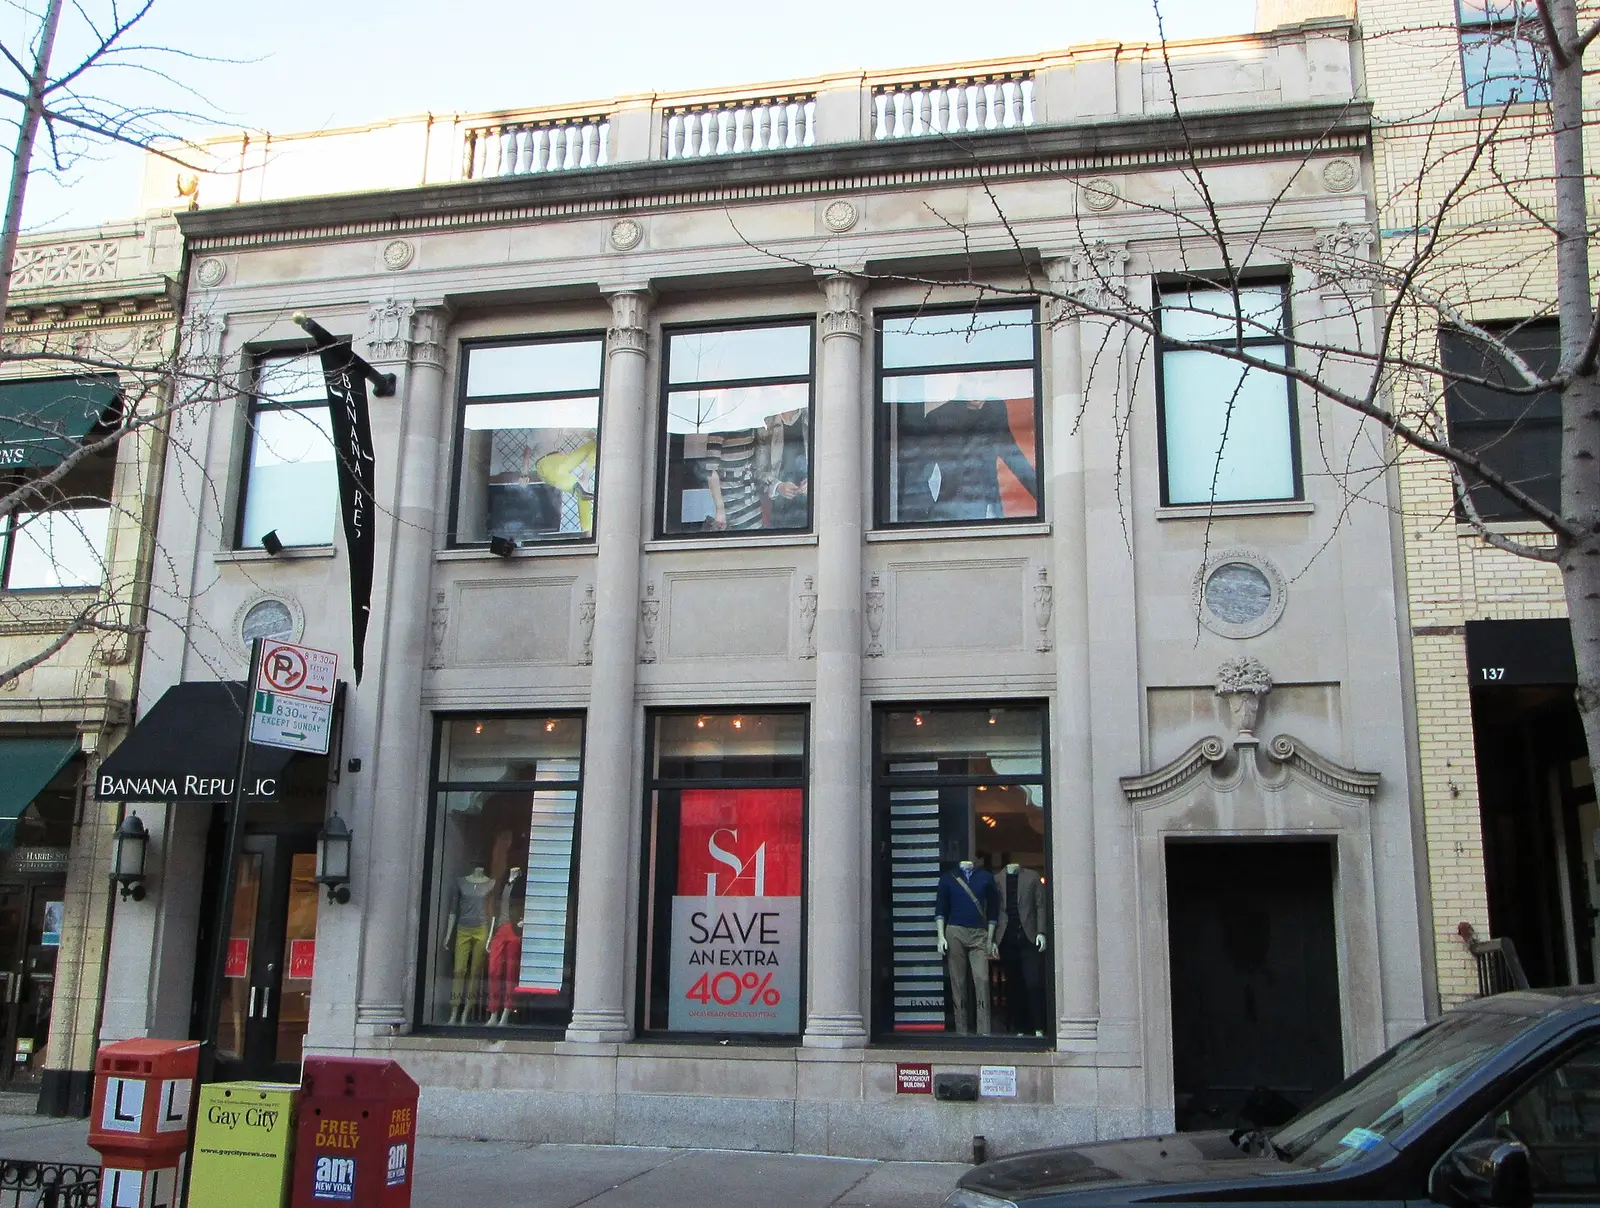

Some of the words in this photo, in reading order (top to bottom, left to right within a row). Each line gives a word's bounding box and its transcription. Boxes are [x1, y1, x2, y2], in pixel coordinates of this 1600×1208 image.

[342, 373, 362, 477] BANANA
[0, 448, 25, 465] NS
[1482, 668, 1505, 680] 137
[261, 715, 290, 728] EXCEPT
[293, 720, 321, 733] SUNDAY
[100, 775, 178, 796] BANANA
[184, 775, 276, 796] REPUIC
[689, 911, 780, 945] SAVE
[688, 949, 715, 966] AN
[719, 949, 779, 966] EXTRA
[685, 971, 781, 1006] 40%
[114, 1080, 135, 1121] L
[166, 1081, 183, 1121] L
[208, 1106, 240, 1130] Gay
[245, 1108, 279, 1132] City
[391, 1108, 411, 1123] FREE
[320, 1119, 358, 1135] FREE
[388, 1121, 412, 1137] DAILY
[315, 1133, 360, 1149] DAILY
[200, 1148, 277, 1158] www.gaycitynews.com
[316, 1157, 354, 1183] am
[315, 1181, 333, 1191] NEW
[333, 1183, 352, 1193] YORK
